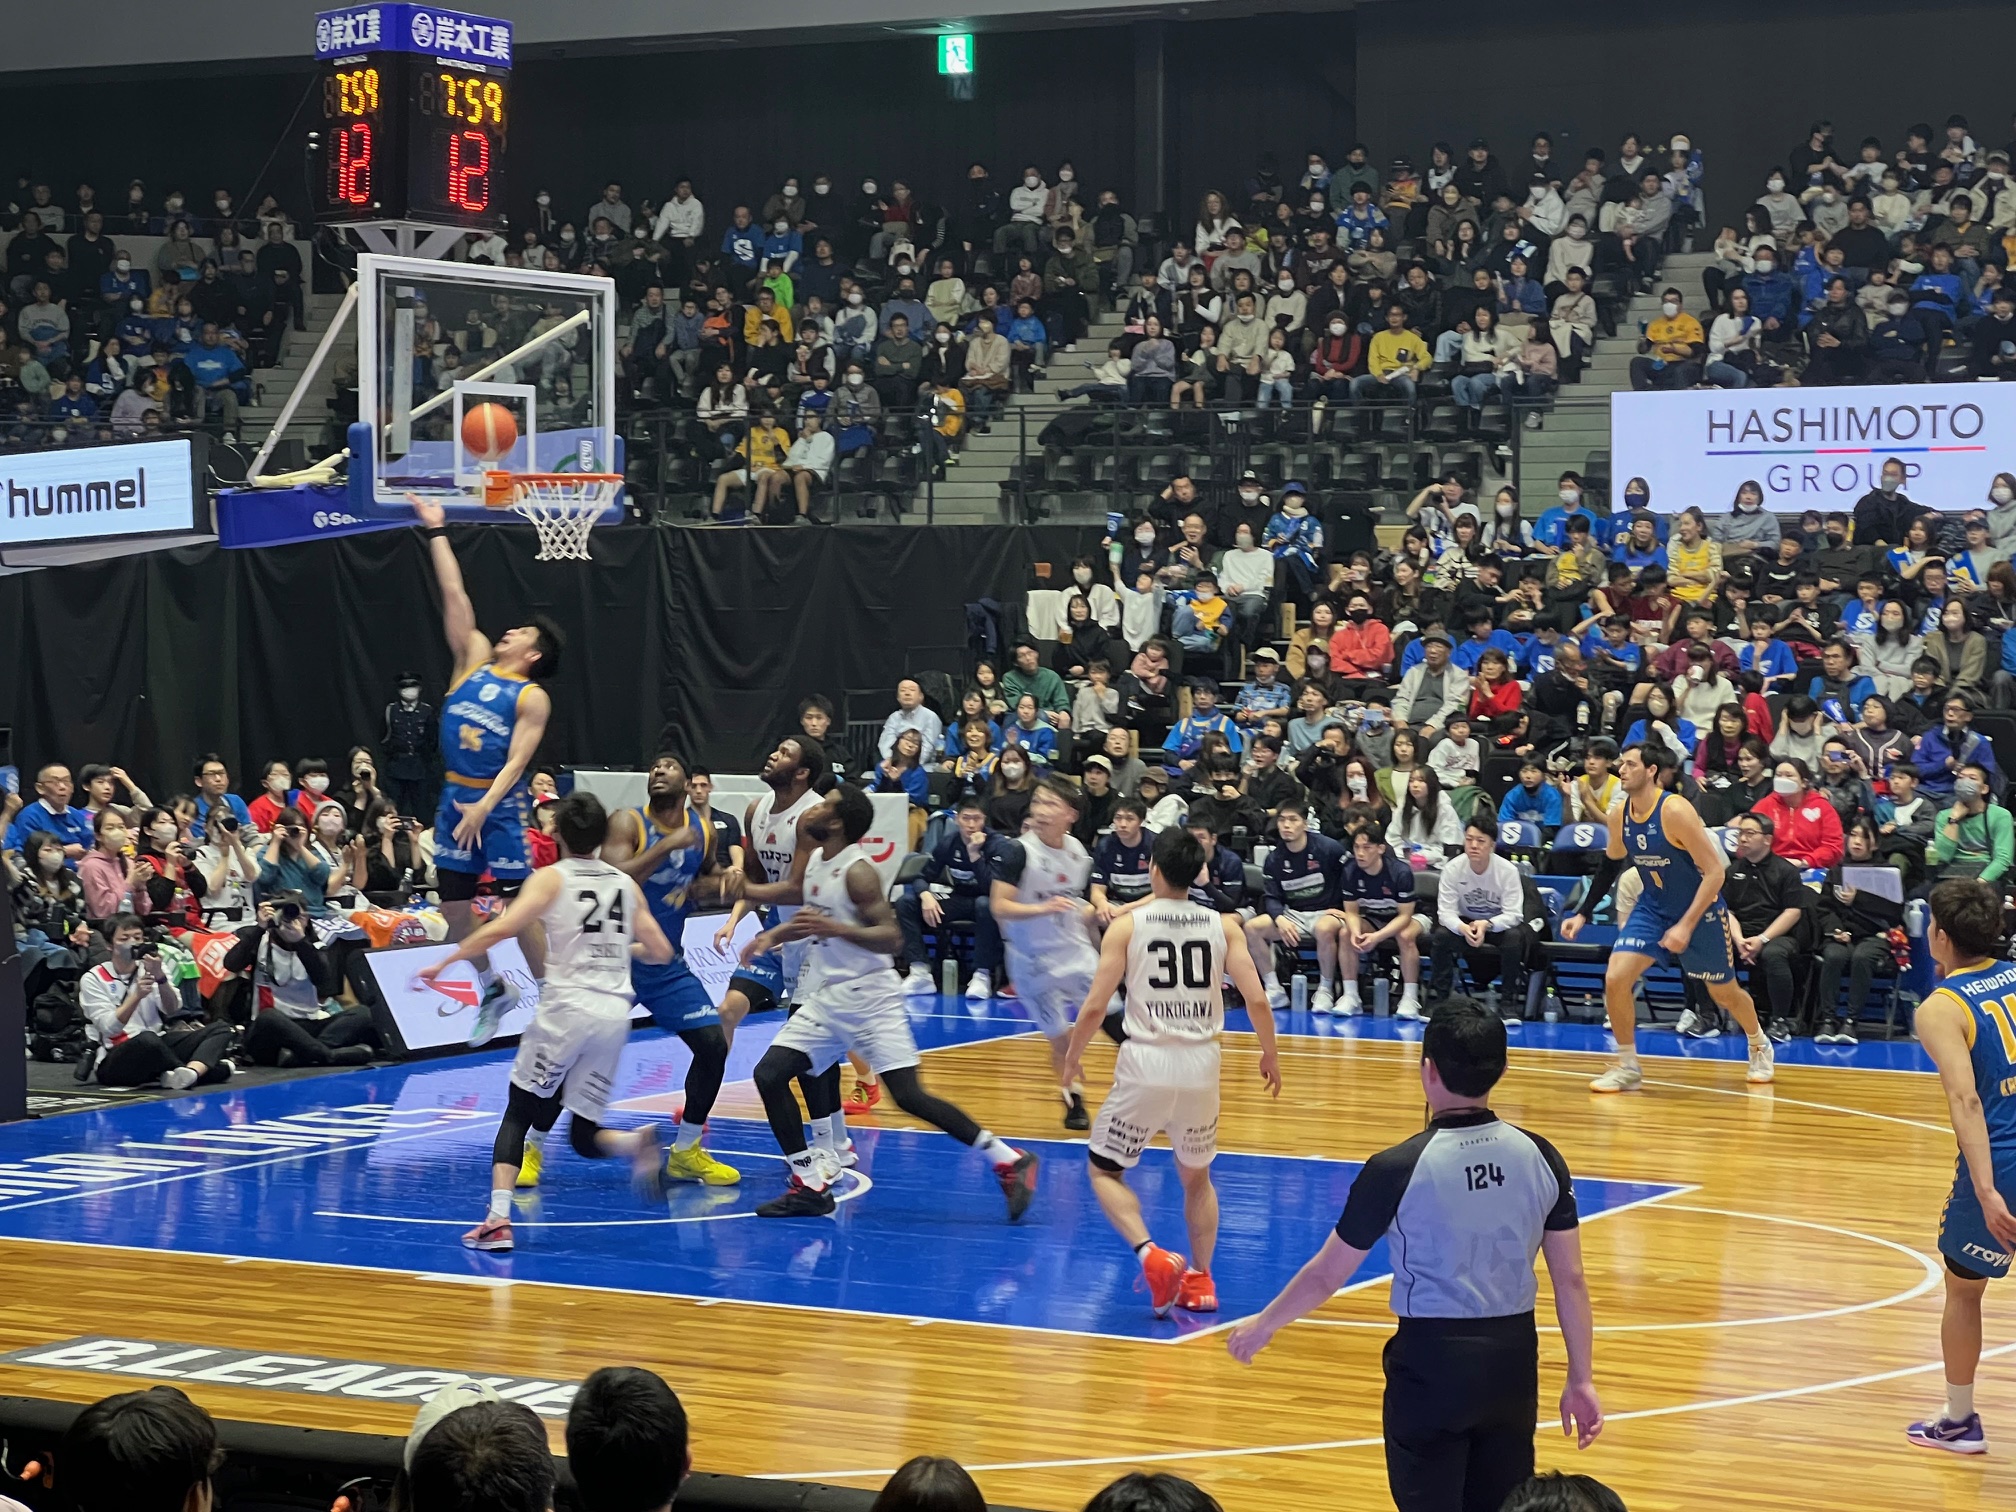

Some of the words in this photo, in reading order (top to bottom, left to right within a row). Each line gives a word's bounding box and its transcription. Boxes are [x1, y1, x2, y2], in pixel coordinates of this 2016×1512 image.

[330, 8, 381, 49] 岸本工業
[435, 16, 510, 60] 岸本工業
[440, 74, 503, 124] 7:59
[338, 123, 372, 204] 12
[449, 130, 489, 212] 12
[1706, 403, 1984, 443] HASHIMOTO
[8, 467, 146, 518] hummel
[578, 888, 625, 934] 24
[1147, 940, 1212, 989] 30
[1960, 967, 2016, 998] HEIWAD
[1145, 1000, 1213, 1020] YOKOGAWA
[116, 1103, 500, 1156] LAKES
[1464, 1162, 1506, 1191] 124
